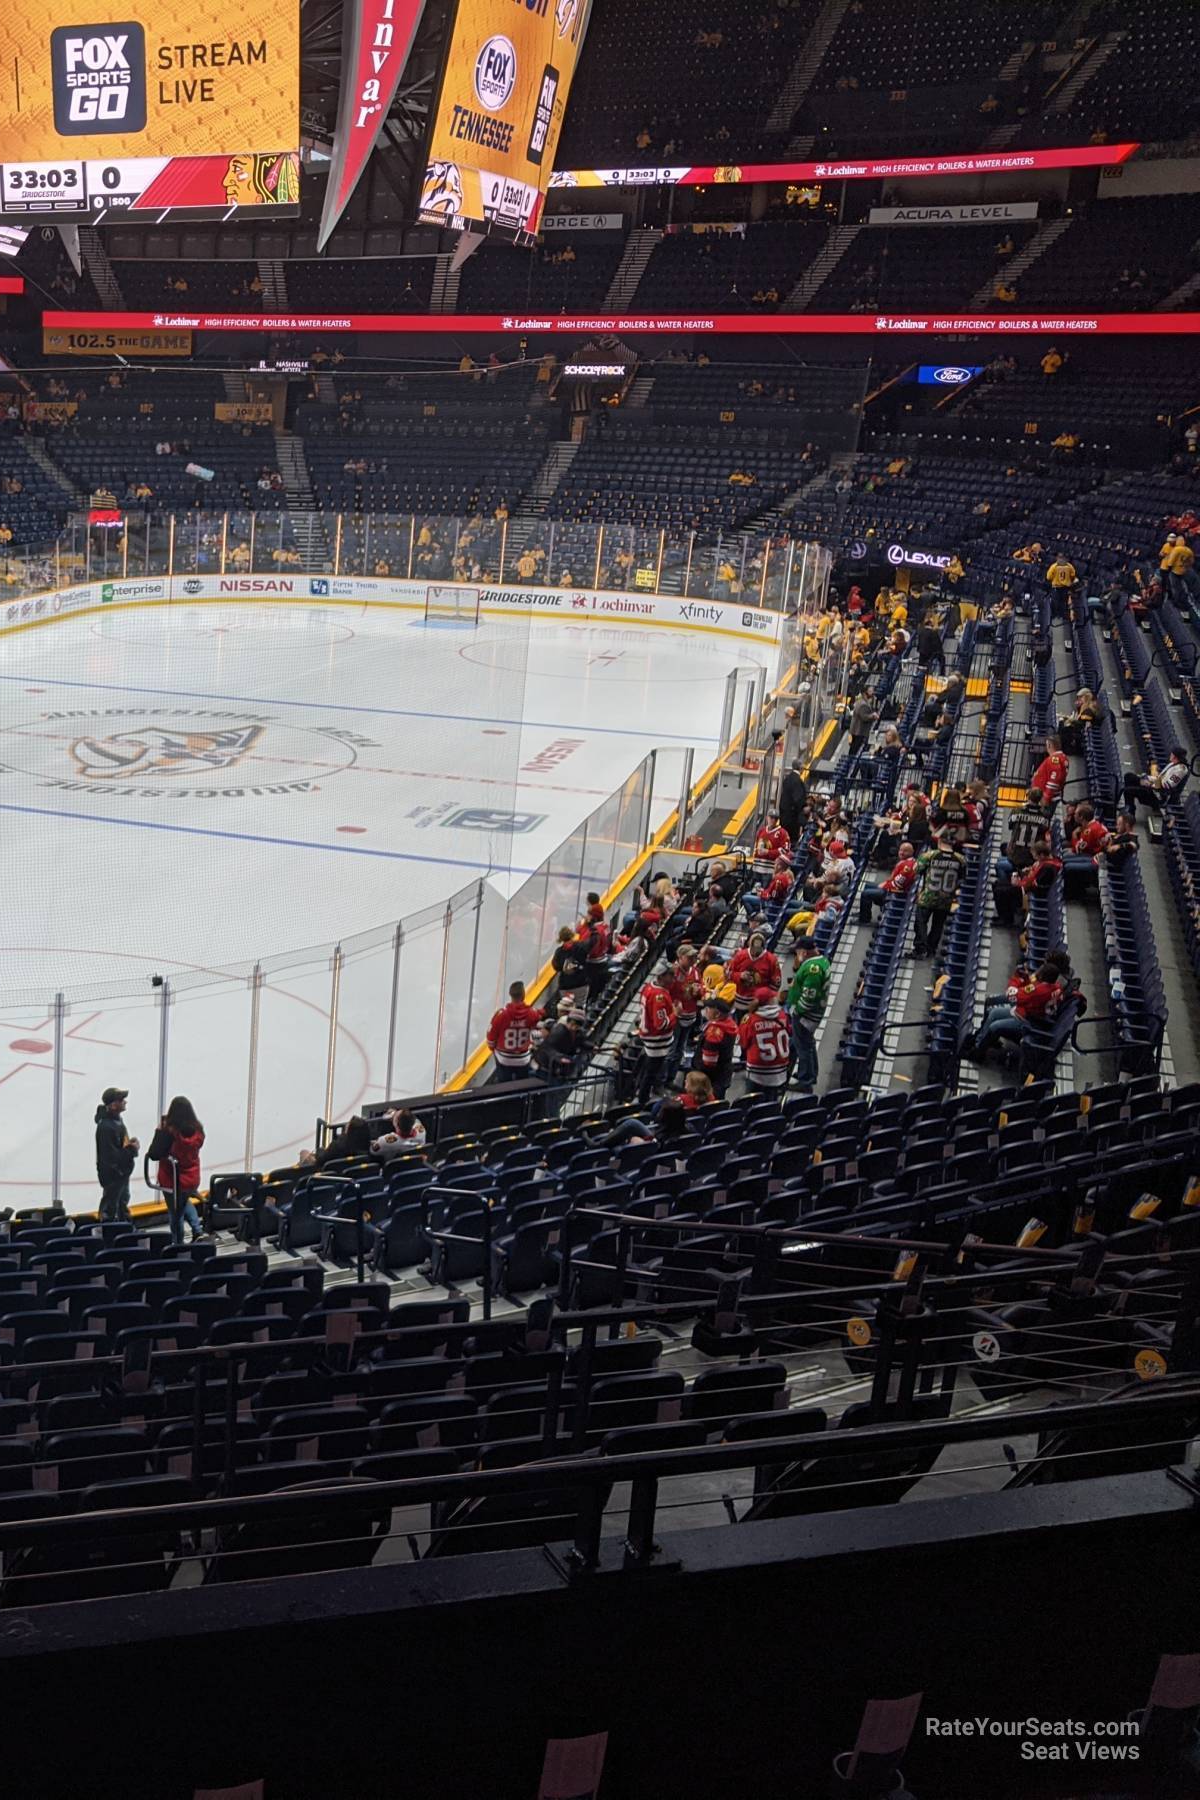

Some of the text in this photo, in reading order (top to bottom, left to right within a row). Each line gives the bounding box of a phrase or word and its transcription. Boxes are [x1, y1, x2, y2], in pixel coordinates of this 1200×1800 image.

[65, 35, 130, 72] FOX
[158, 40, 267, 70] STREAM
[484, 48, 511, 86] FOX
[66, 70, 131, 87] SPORTS
[159, 79, 214, 104] LIVE
[481, 79, 506, 98] SPORTS
[69, 85, 129, 121] GO
[449, 105, 514, 154] TENNESSEE
[612, 171, 620, 179] 0
[663, 170, 671, 178] 0
[828, 157, 1035, 177] Lochinvar HIGH EFFICIENCY BOILERS WATER HEATERS
[9, 168, 78, 189] 33:03
[101, 166, 122, 190] 0
[21, 189, 66, 199] BRIDGESTONE
[93, 196, 131, 209] 0 SOG
[492, 181, 499, 203] 0
[524, 191, 531, 212] 0
[452, 213, 465, 230] NHL
[894, 206, 1014, 220] ACURA LEVEL
[165, 316, 352, 328] Lochinvar HIGH EFFICIENCY BOILERS WATER HEATERS
[514, 319, 714, 330] Lochinvar HIGH EFFICIENCY BOILERS WATER HEATERS
[887, 319, 1098, 330] Lochinvar HIGH EFFICIENCY BOILERS WATER HEATERS
[68, 334, 189, 349] 102.5 THE GAME
[938, 369, 966, 382] Ford
[102, 583, 162, 599] enterprise
[220, 580, 294, 592] NISSAN
[479, 590, 563, 607] BRIDGESTONE
[591, 596, 656, 614] Lochinvar
[679, 602, 724, 624] xfinity
[42, 707, 282, 722] BRIDGESTONE
[520, 738, 586, 773] NISSAN
[37, 778, 321, 799] BRIDGESTONE
[1017, 826, 1038, 848] 11
[928, 870, 958, 893] 50
[504, 1028, 530, 1049] 88
[756, 1028, 791, 1062] 50
